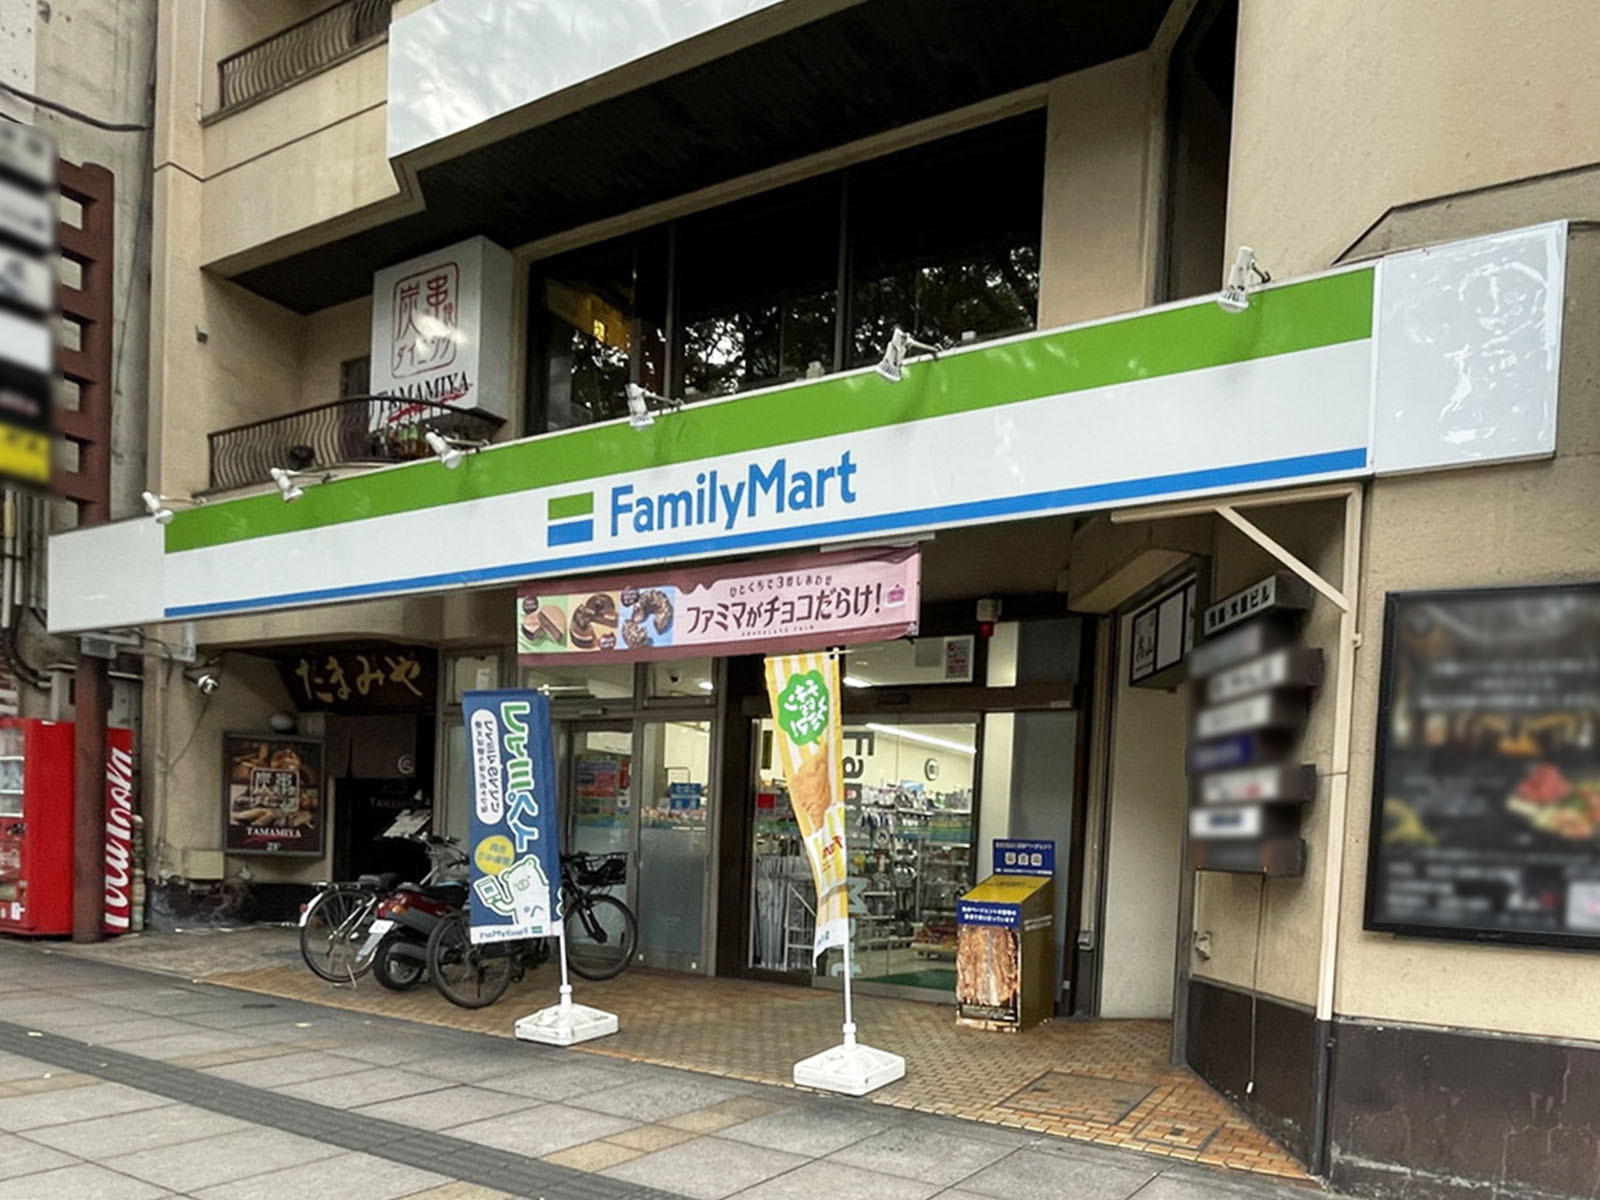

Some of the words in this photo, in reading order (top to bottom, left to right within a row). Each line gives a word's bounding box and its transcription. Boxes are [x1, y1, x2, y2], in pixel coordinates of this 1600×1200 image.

[611, 450, 857, 537] FamilyMart
[686, 582, 882, 634] ファミマがチョコだらけ!
[296, 655, 424, 702] たまみや
